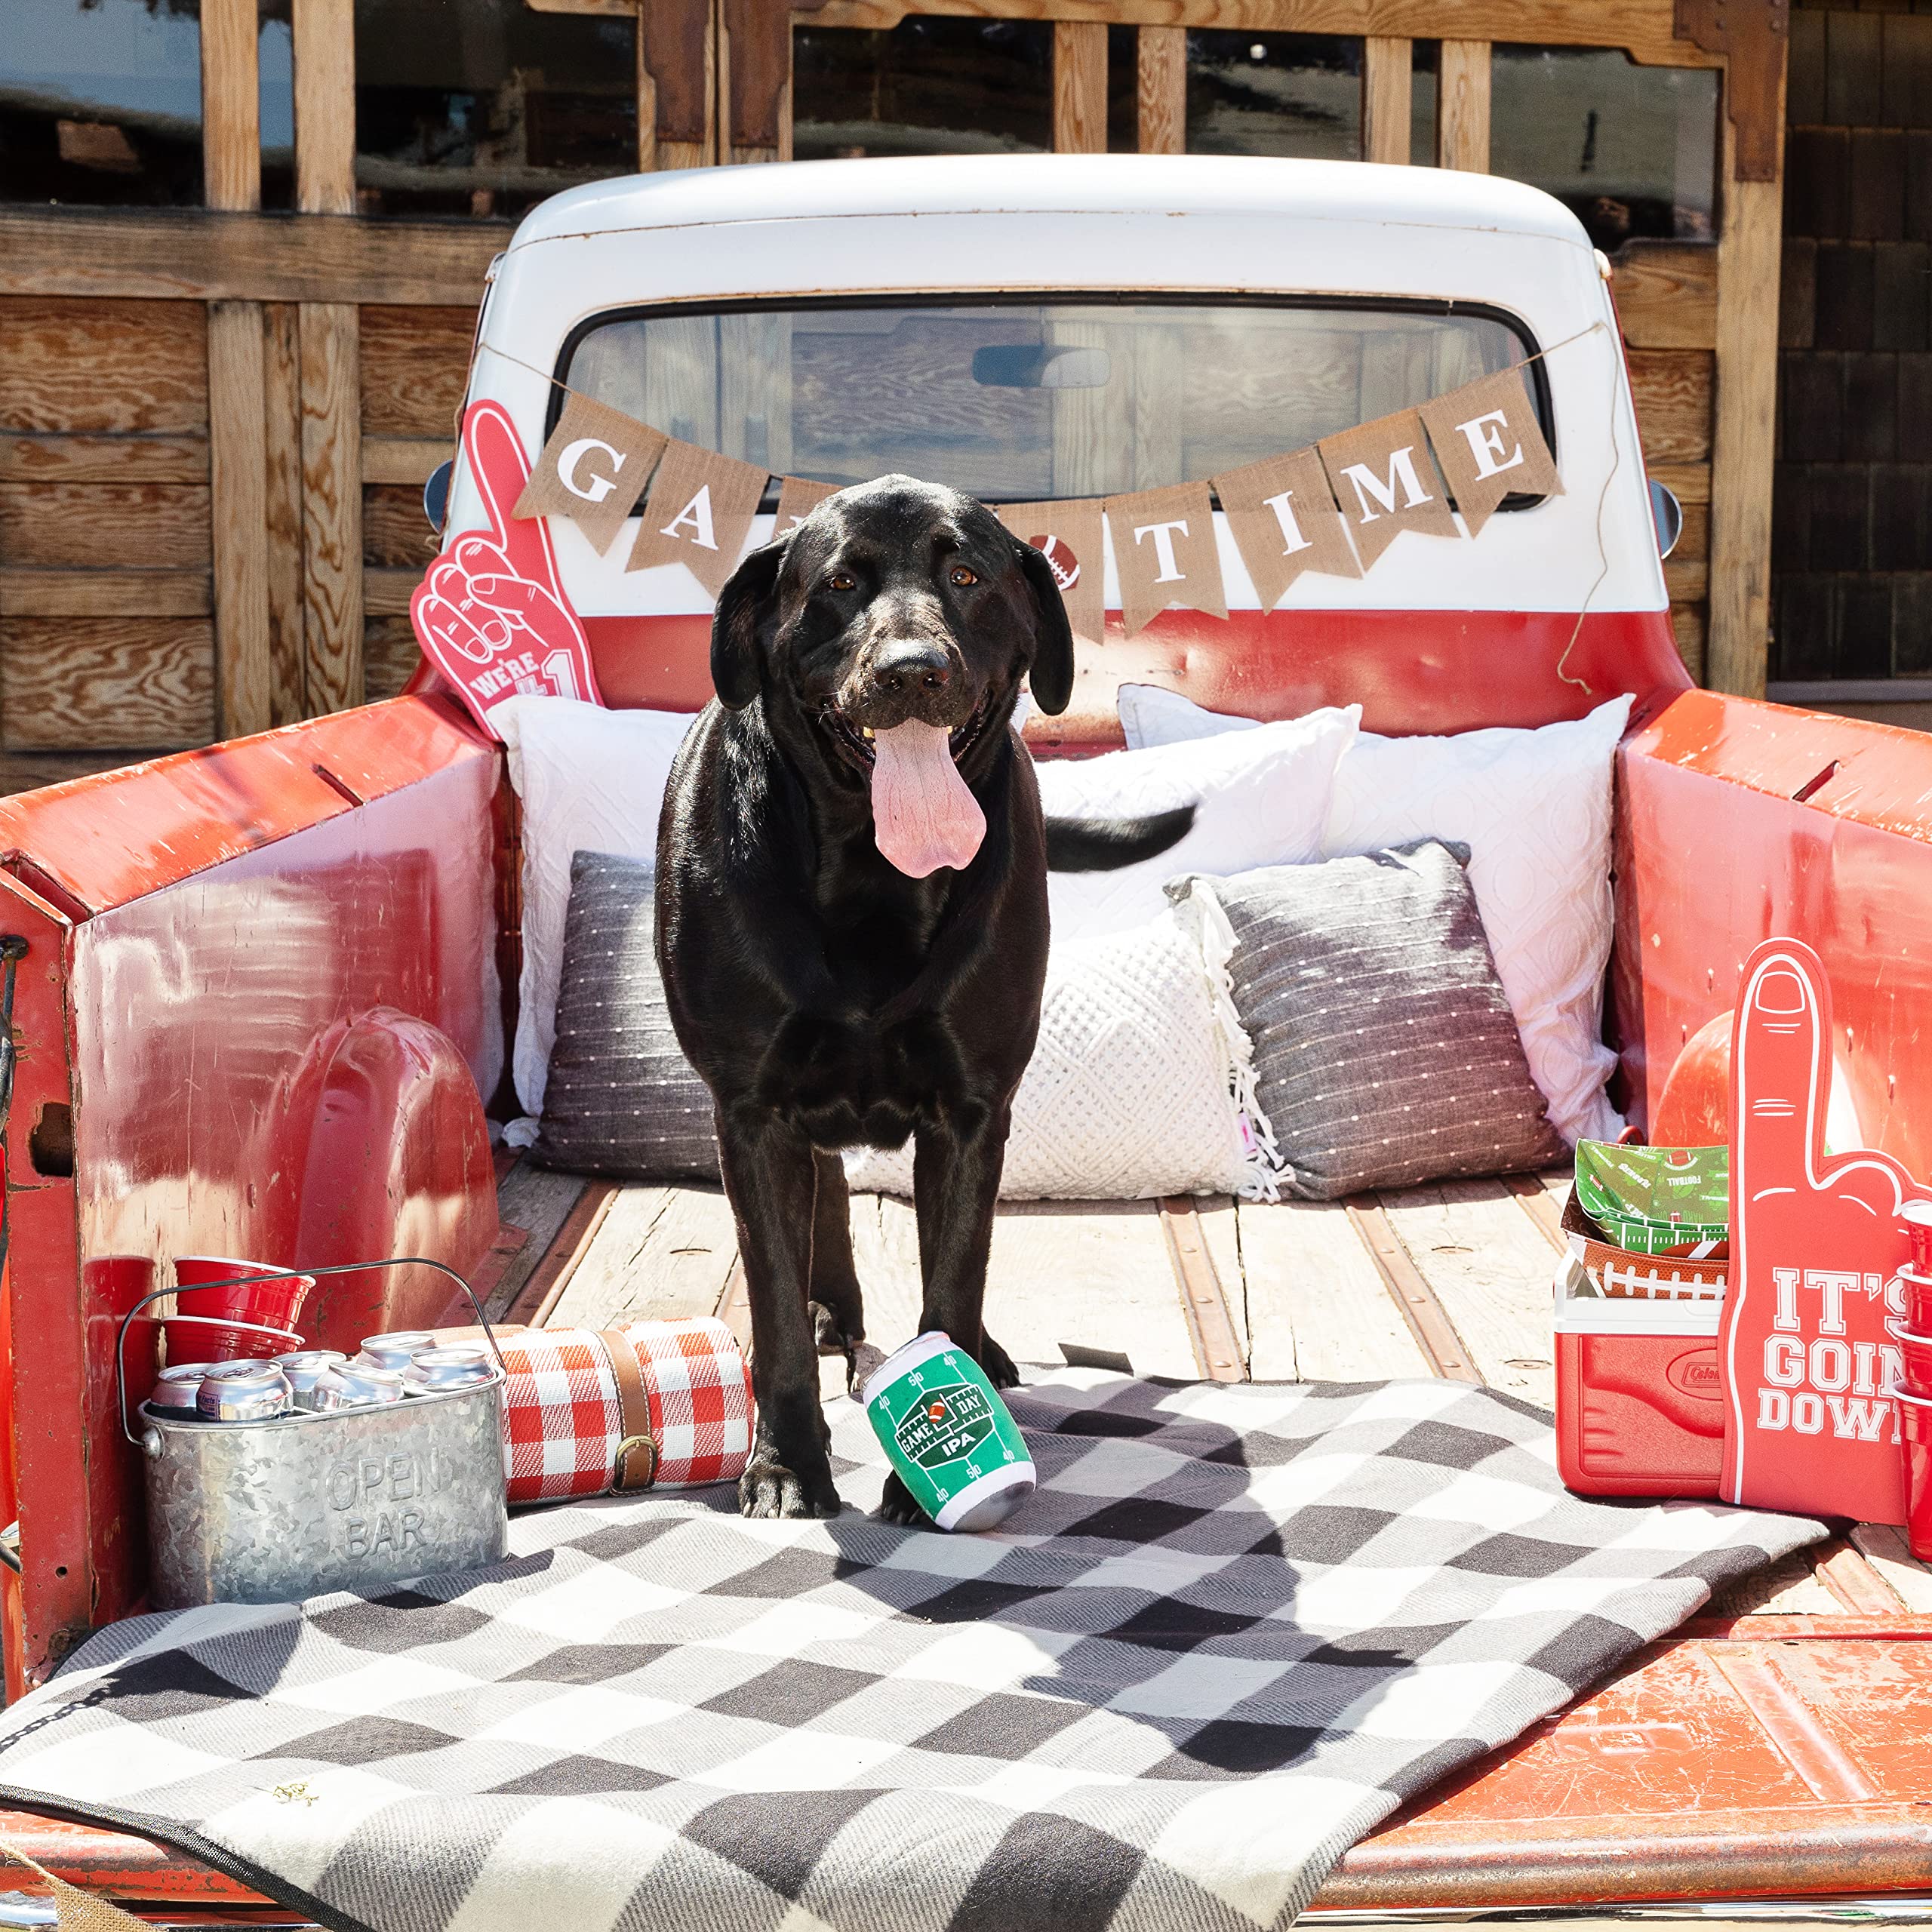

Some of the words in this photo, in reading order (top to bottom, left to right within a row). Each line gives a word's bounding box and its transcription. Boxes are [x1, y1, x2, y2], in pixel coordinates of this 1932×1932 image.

[1134, 409, 1524, 583] TIME
[469, 651, 540, 700] WE'RE
[1666, 1175, 1702, 1186] FOOTBALL
[943, 1355, 957, 1367] 40
[1690, 1366, 1720, 1380] Cole
[1764, 1334, 1903, 1398] GOIN
[908, 1371, 924, 1386] 50
[878, 1396, 891, 1411] 40
[1757, 1388, 1902, 1444] DOW
[900, 1422, 934, 1452] GAME
[955, 1394, 982, 1415] DAY
[941, 1432, 977, 1457] IPA
[325, 1447, 441, 1512] OPEN
[966, 1464, 983, 1480] 50
[936, 1487, 949, 1503] 40
[343, 1506, 427, 1561] BAR
